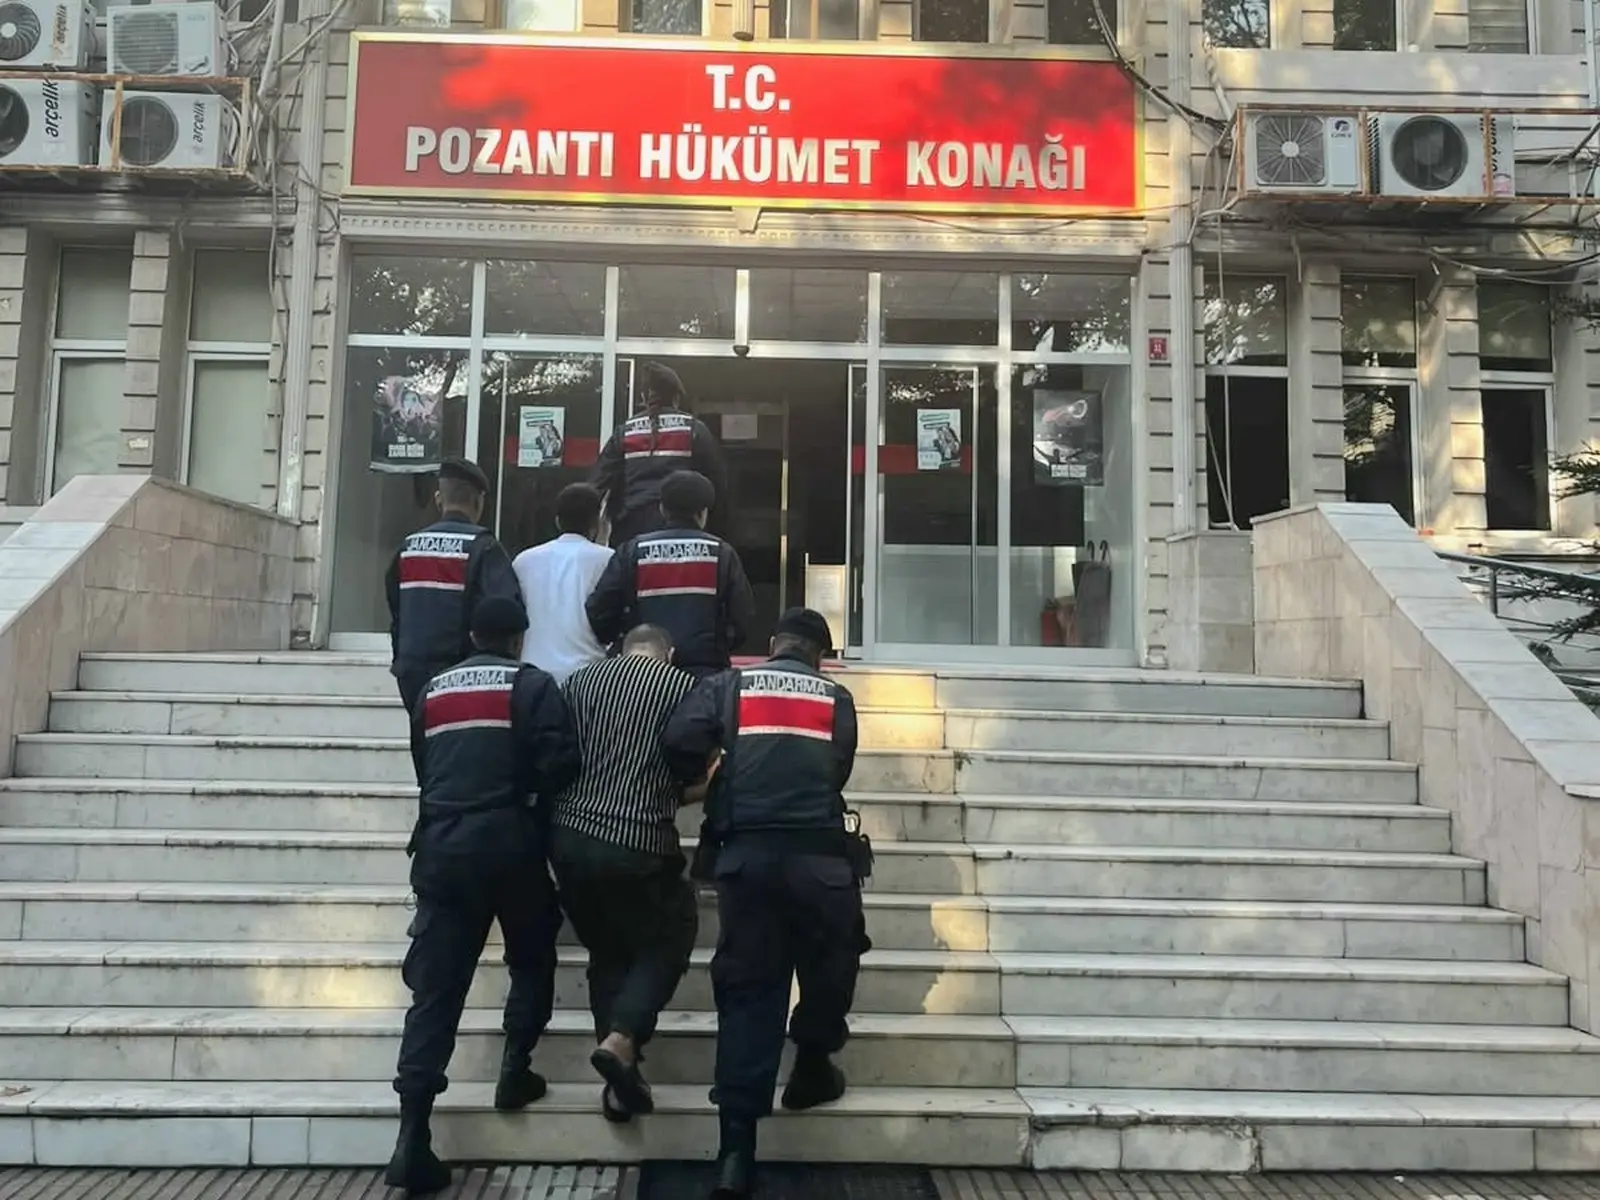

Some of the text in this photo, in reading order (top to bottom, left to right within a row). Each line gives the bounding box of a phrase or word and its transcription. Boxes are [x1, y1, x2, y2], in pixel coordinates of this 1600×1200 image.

[705, 64, 791, 111] T.C.
[42, 76, 62, 138] arçelik
[404, 123, 1086, 190] POZANTI HÜKÜMET KONAĞI
[407, 536, 463, 553] JANDARMA
[645, 543, 710, 560] JANDARMA
[434, 670, 506, 691] JANDARMA
[749, 674, 827, 695] JANDARMA
